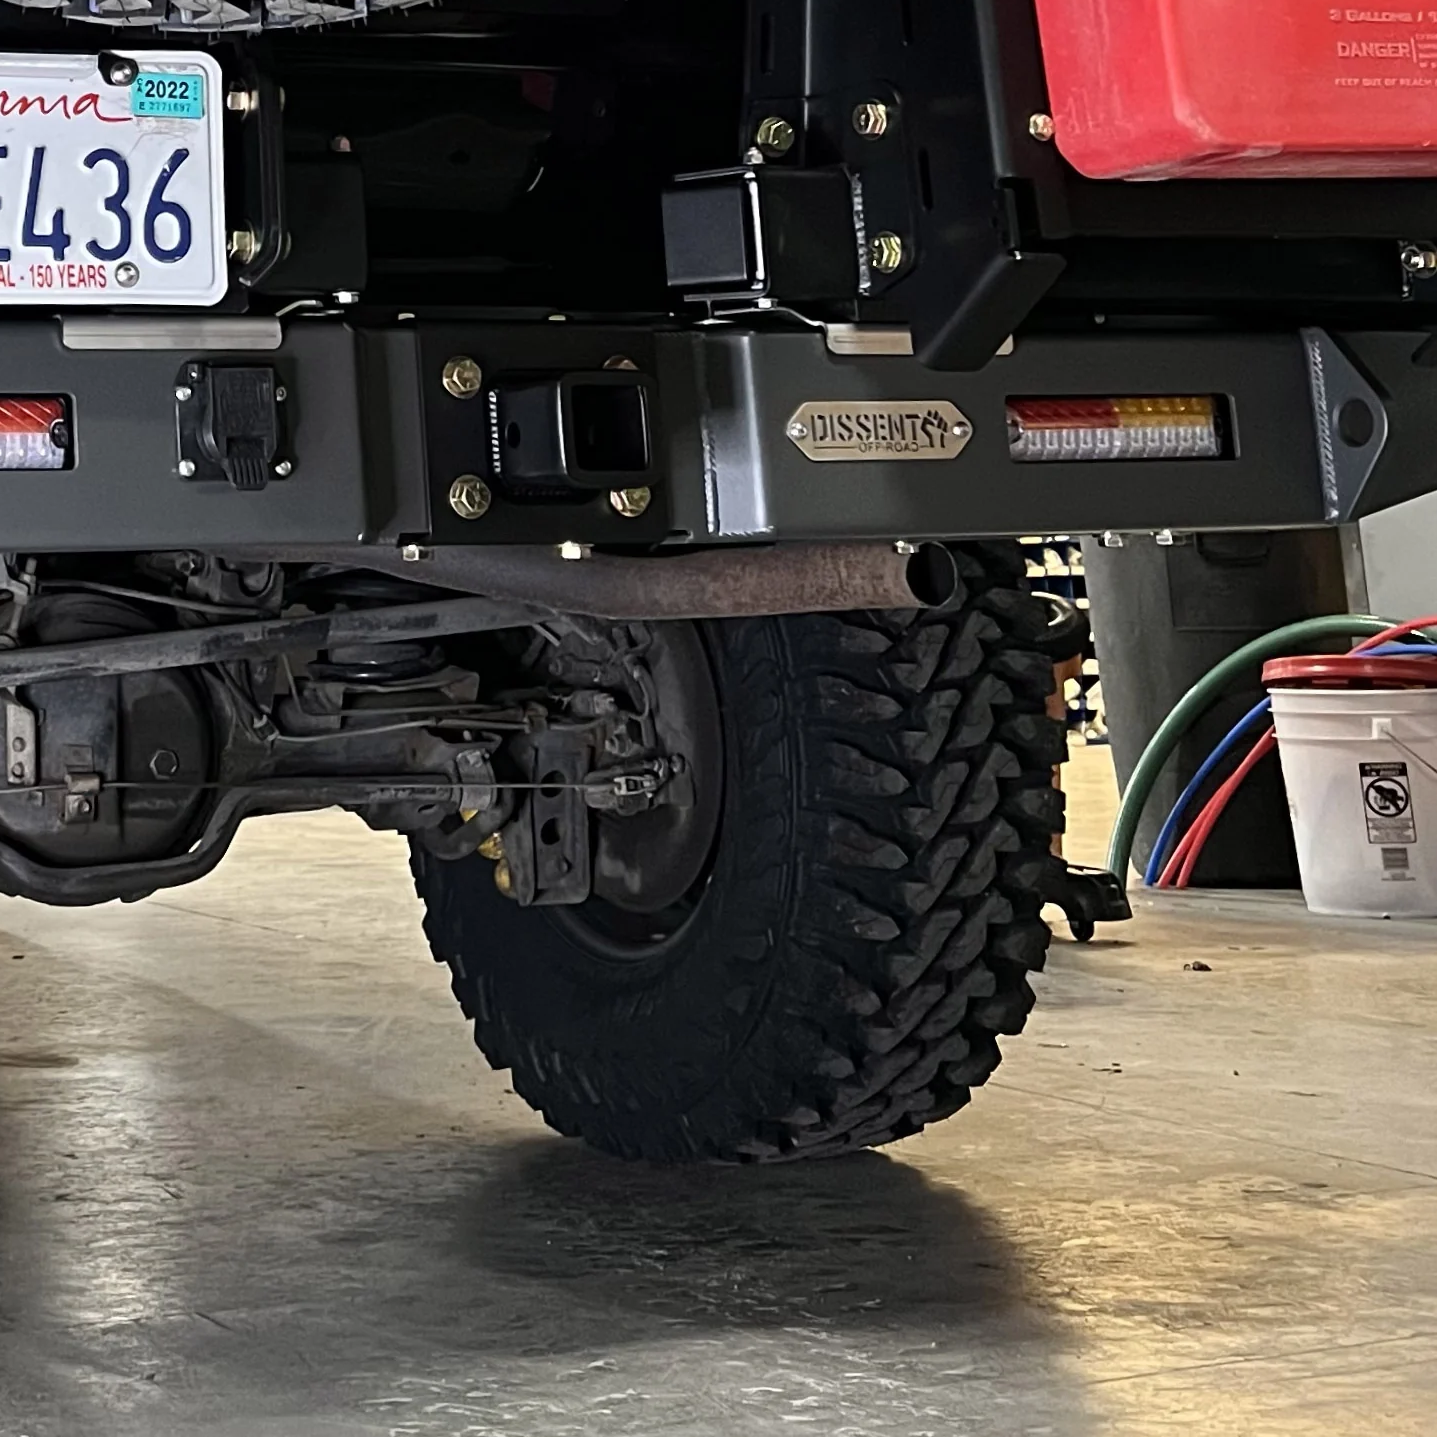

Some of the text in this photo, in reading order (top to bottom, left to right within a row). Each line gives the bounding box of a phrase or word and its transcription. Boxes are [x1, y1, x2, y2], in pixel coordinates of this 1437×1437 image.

[1337, 41, 1411, 58] DANGER
[144, 79, 189, 100] 2022
[30, 265, 54, 289] 150
[56, 265, 108, 289] YEARS
[810, 414, 922, 442] DISSENT
